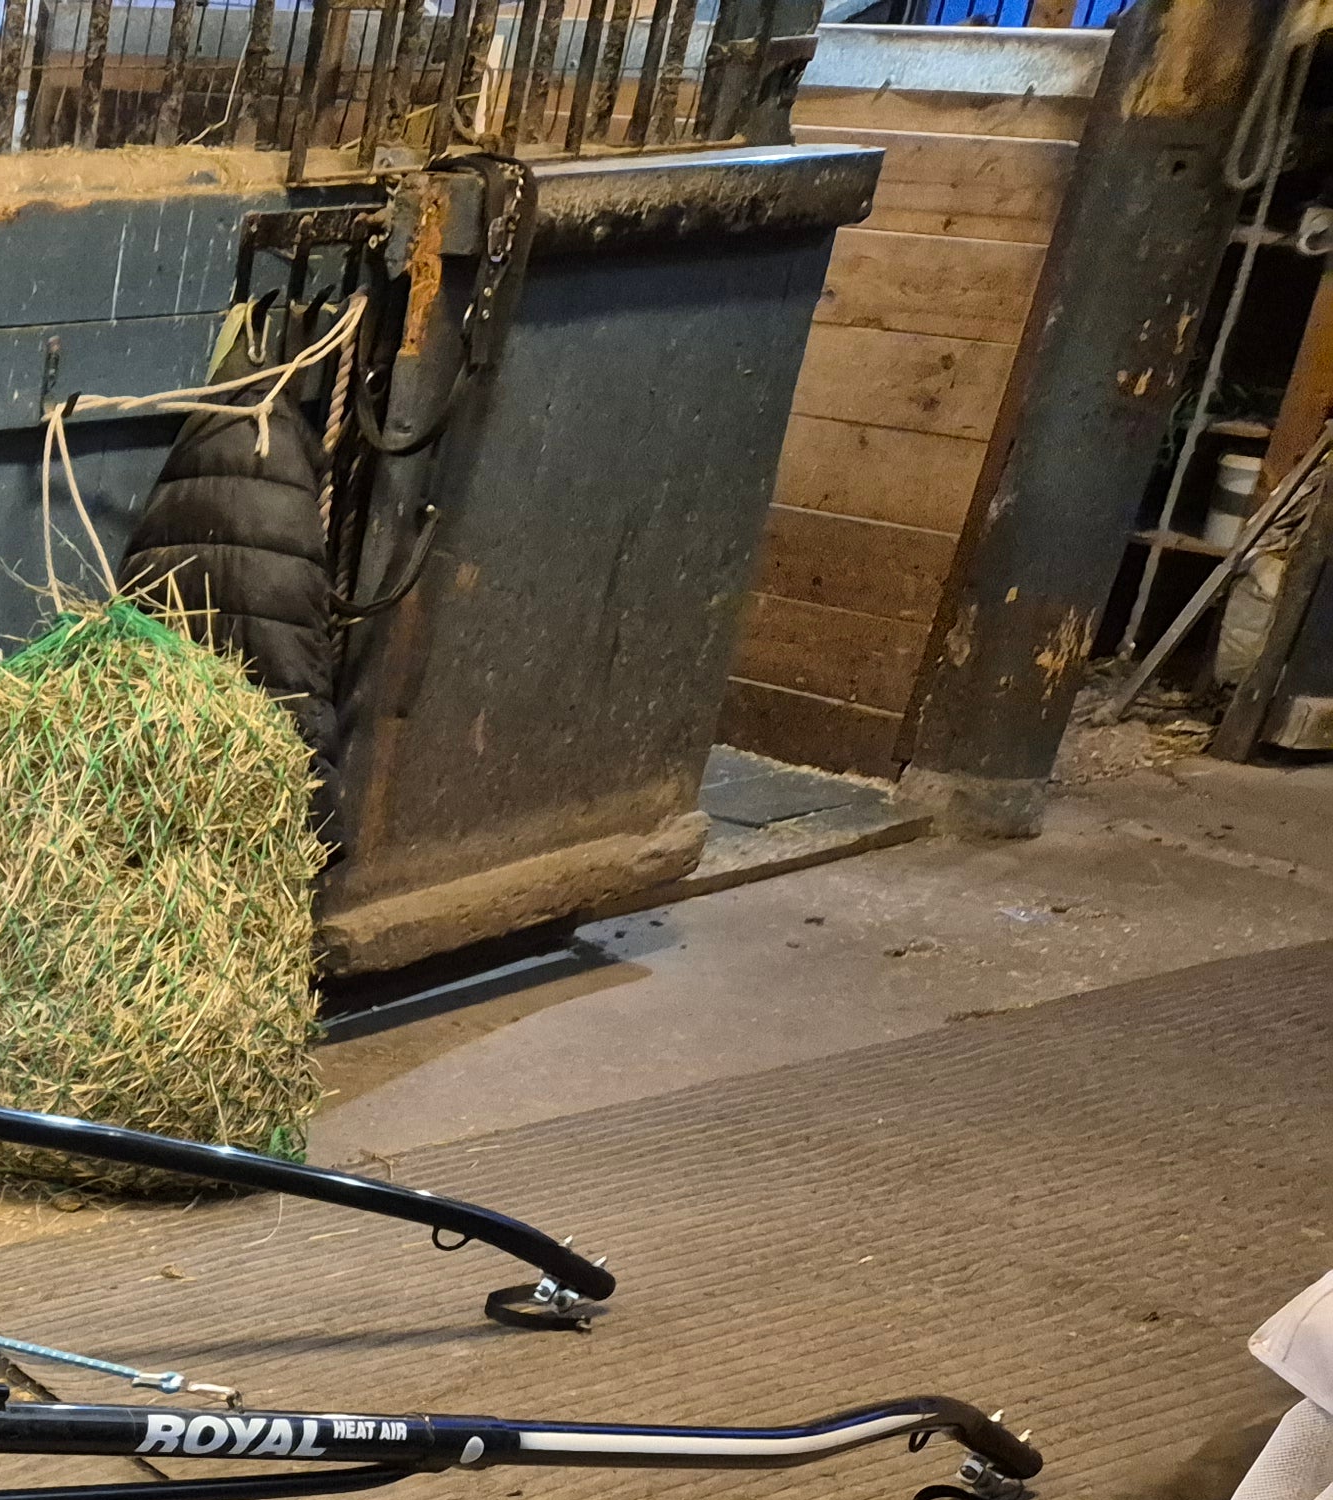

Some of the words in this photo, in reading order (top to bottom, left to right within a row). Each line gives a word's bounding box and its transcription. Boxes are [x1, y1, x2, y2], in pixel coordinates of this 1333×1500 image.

[135, 1414, 328, 1457] ROYAL
[332, 1420, 376, 1440] HEAT
[379, 1421, 408, 1441] AIR
